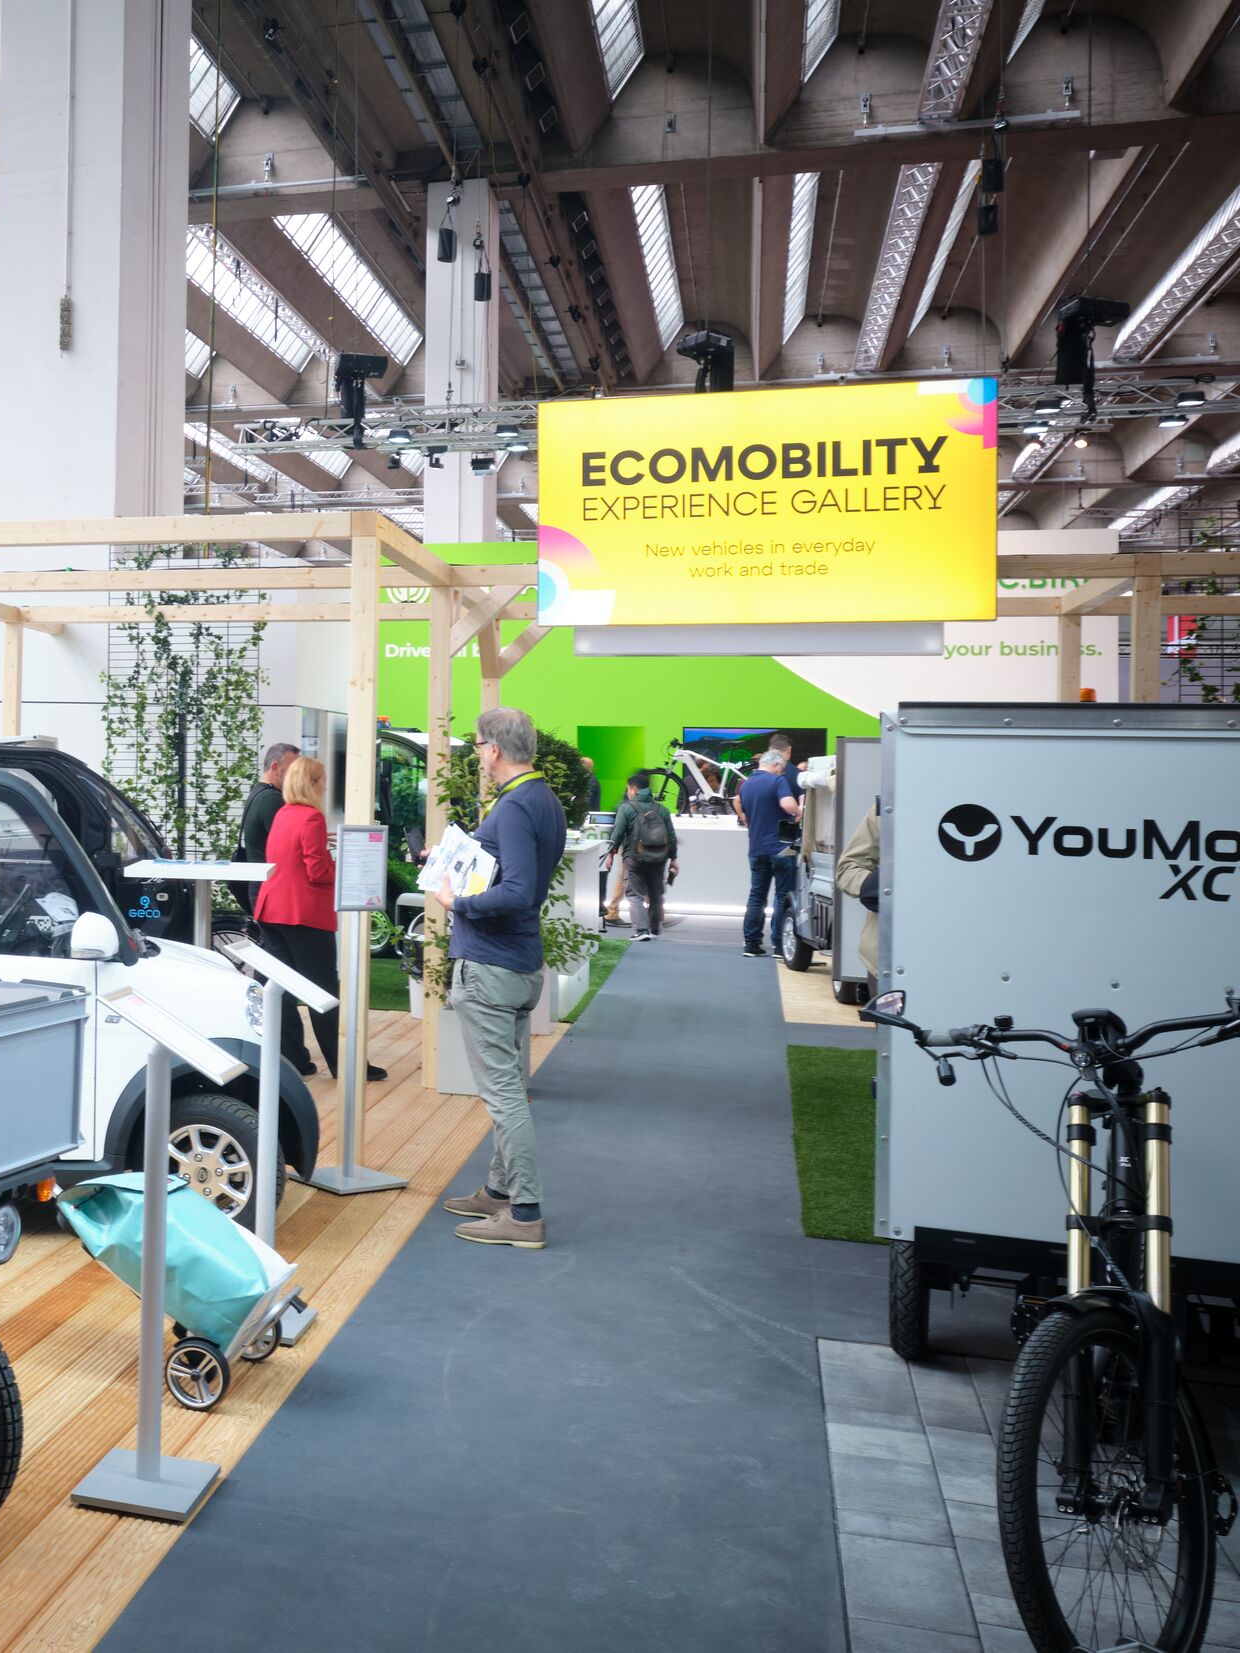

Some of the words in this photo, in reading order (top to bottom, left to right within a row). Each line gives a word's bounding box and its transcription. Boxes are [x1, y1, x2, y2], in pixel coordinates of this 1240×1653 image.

[582, 436, 949, 487] ECOMOBILITY
[583, 490, 777, 521] EXPERIENCE
[791, 484, 947, 515] GALLERY
[645, 543, 686, 557] New
[691, 540, 764, 556] vehicles
[770, 540, 785, 554] in
[792, 537, 876, 556] everyday
[688, 562, 734, 578] work
[739, 561, 773, 577] and
[780, 560, 829, 576] trade
[943, 643, 992, 660] your
[999, 640, 1102, 657] businss.
[1010, 815, 1240, 862] YouMo
[1158, 864, 1237, 902] XC
